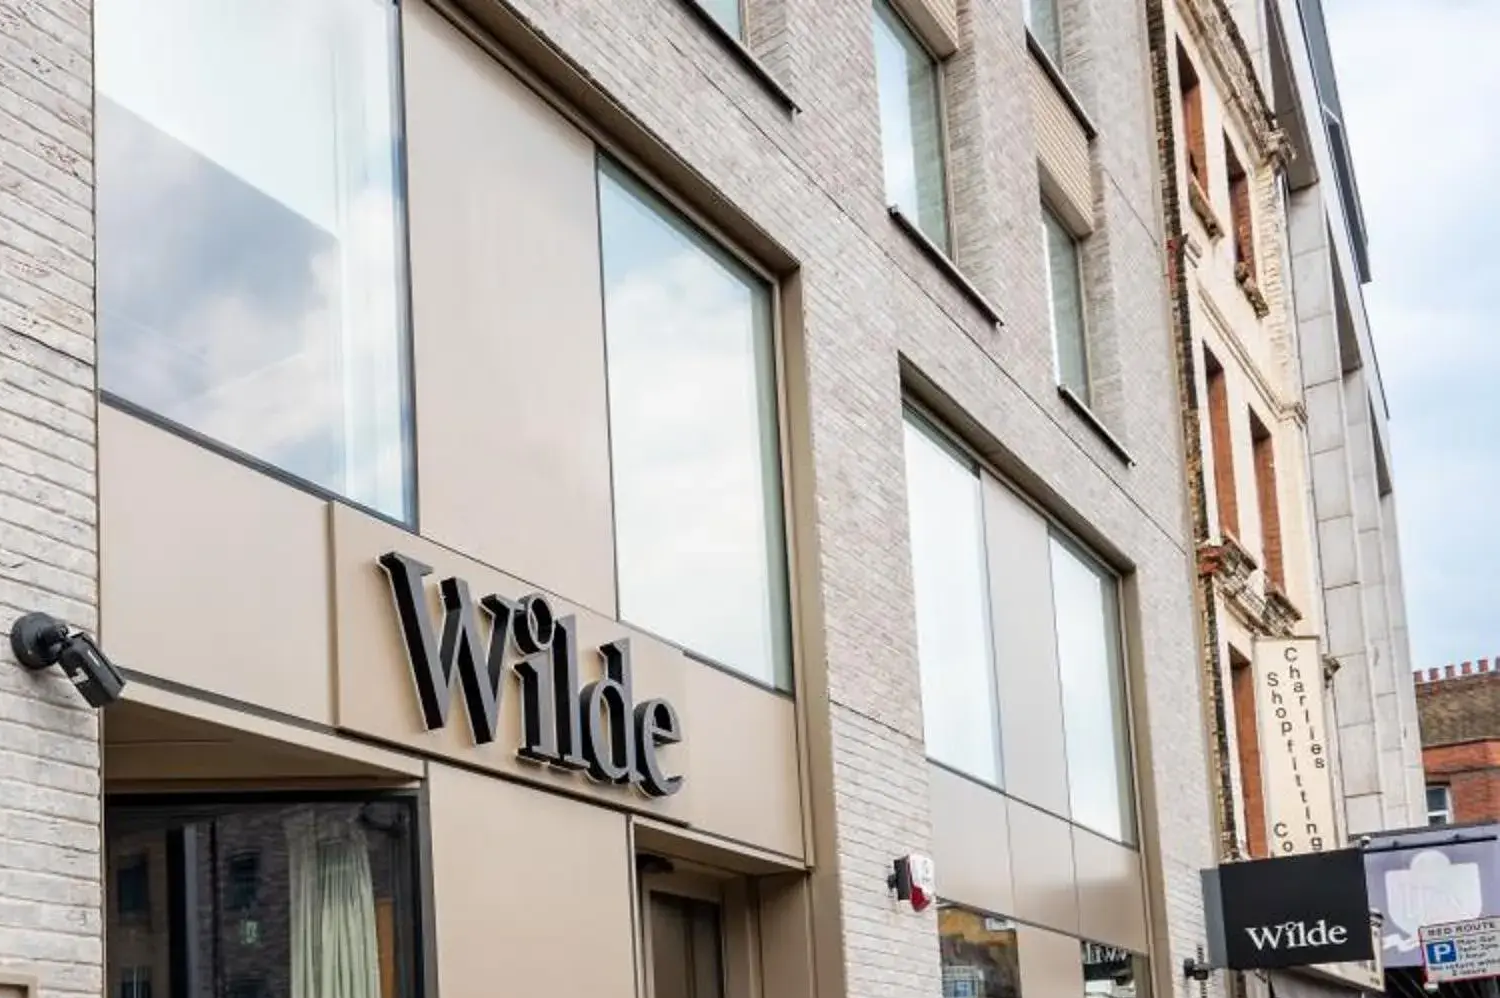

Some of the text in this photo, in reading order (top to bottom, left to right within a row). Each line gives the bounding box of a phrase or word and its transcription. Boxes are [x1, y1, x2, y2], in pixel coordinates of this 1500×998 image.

[375, 550, 687, 799] Wilde
[1283, 646, 1326, 770] Charlies
[1245, 919, 1348, 951] Wilde
[1433, 943, 1451, 963] P
